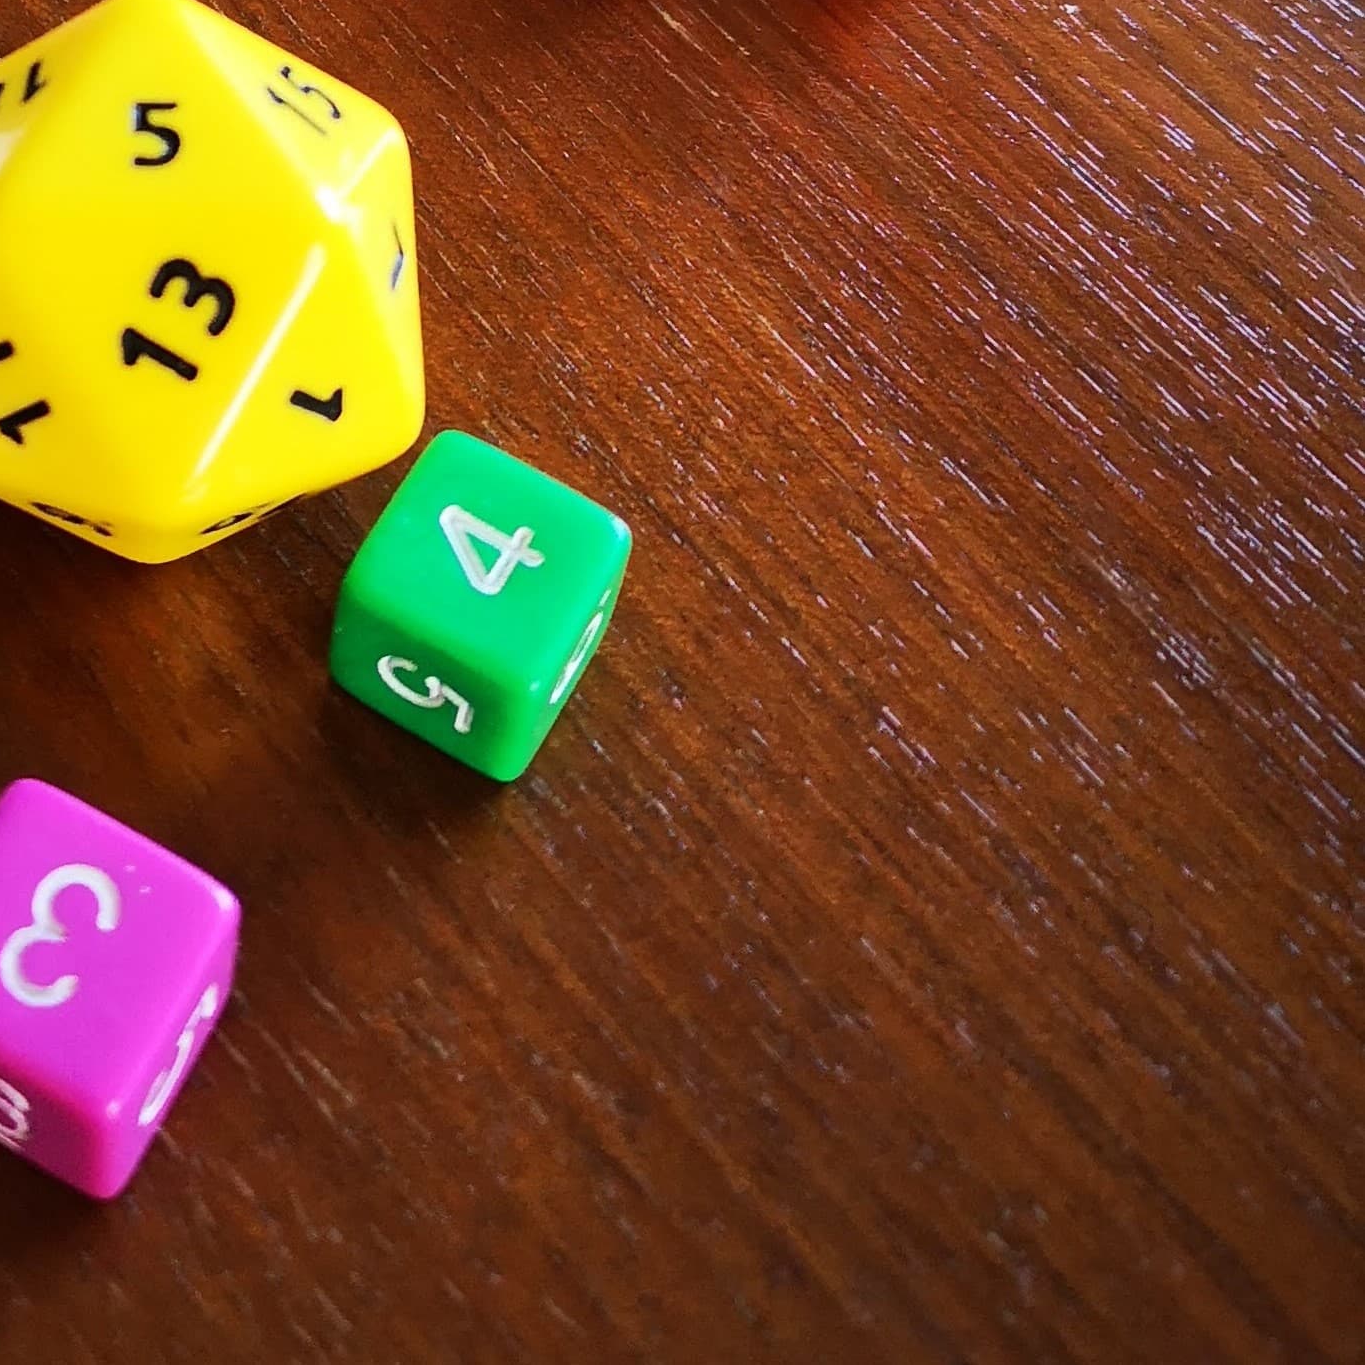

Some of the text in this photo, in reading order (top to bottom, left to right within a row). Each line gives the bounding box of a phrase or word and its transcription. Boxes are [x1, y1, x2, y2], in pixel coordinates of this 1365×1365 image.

[133, 102, 181, 167] 5
[266, 65, 341, 135] 15
[120, 257, 236, 382] 13
[289, 387, 343, 422] 1
[438, 504, 546, 596] 4
[377, 654, 475, 734] 5
